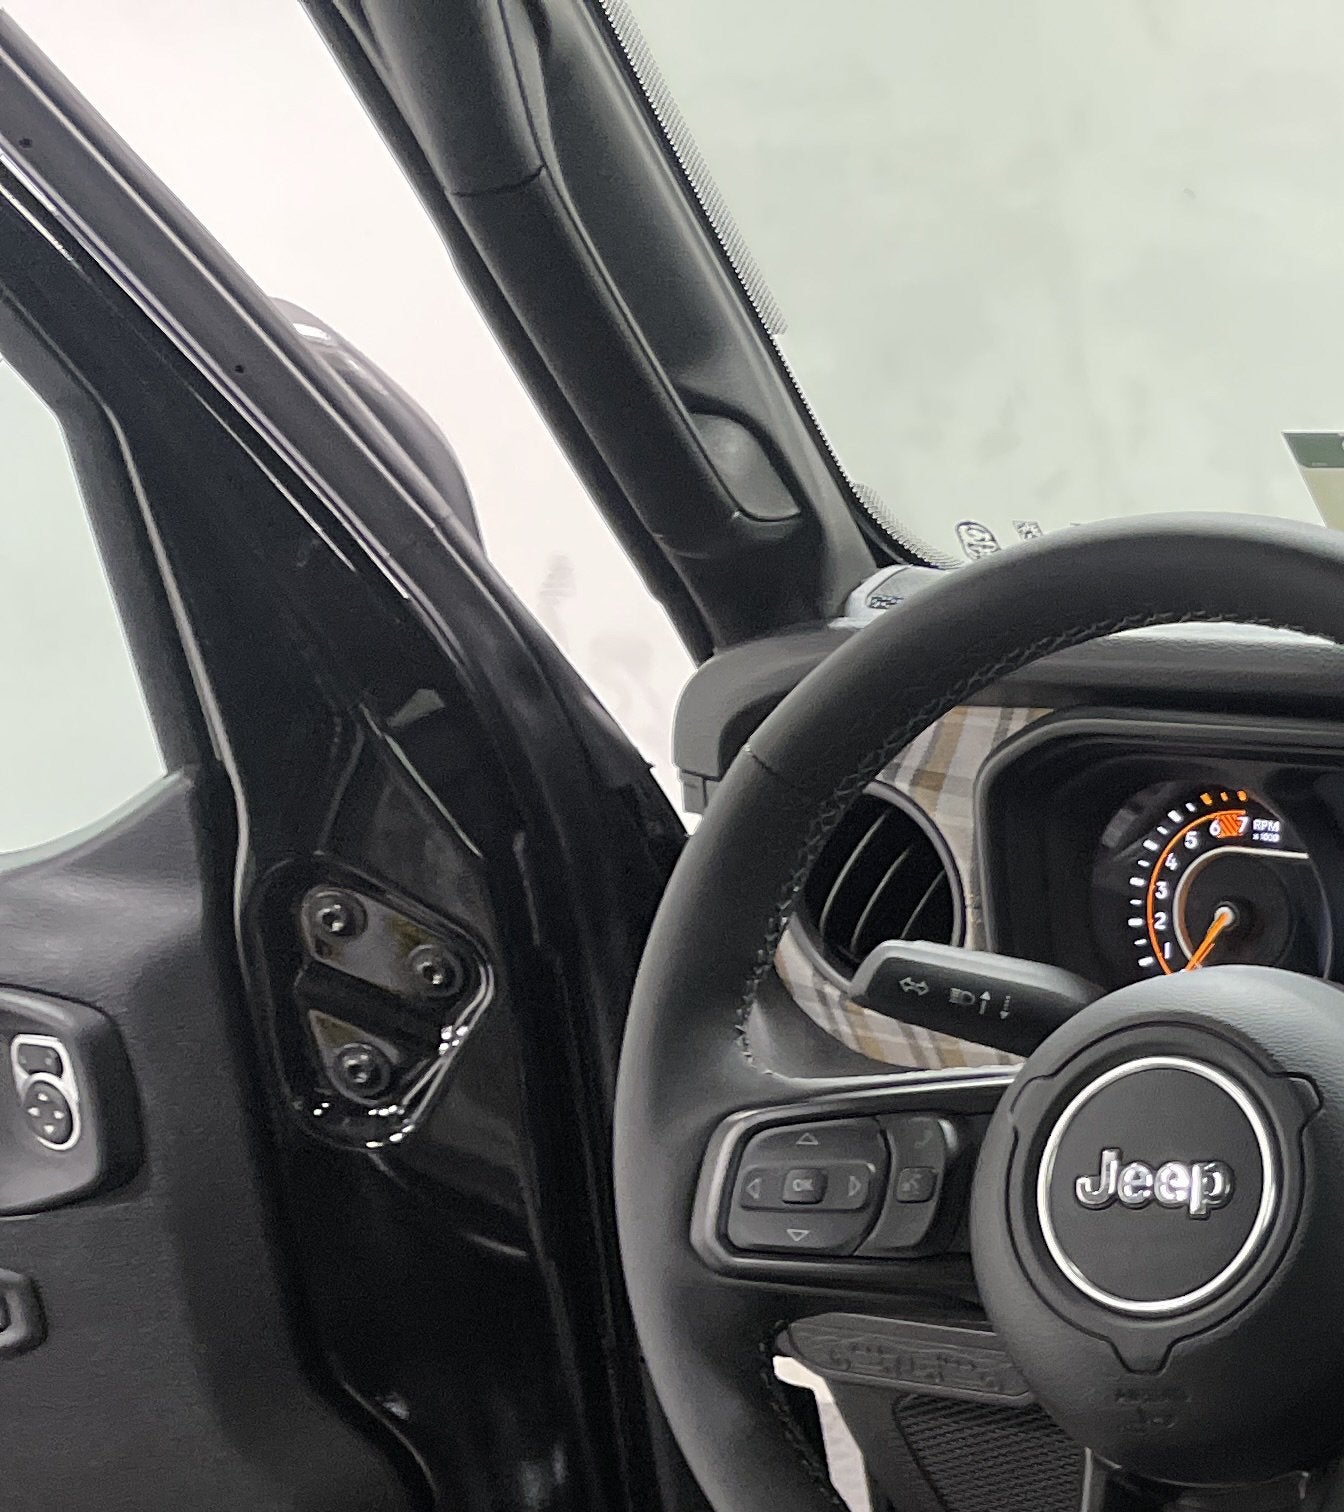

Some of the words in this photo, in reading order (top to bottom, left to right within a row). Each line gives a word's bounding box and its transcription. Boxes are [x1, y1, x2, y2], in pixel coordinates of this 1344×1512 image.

[1253, 819, 1280, 832] RPM
[1184, 831, 1198, 849] 5
[1165, 852, 1178, 871] 4
[1155, 881, 1168, 899] 3
[1154, 911, 1167, 930] 2
[1076, 1148, 1235, 1219] Jeep
